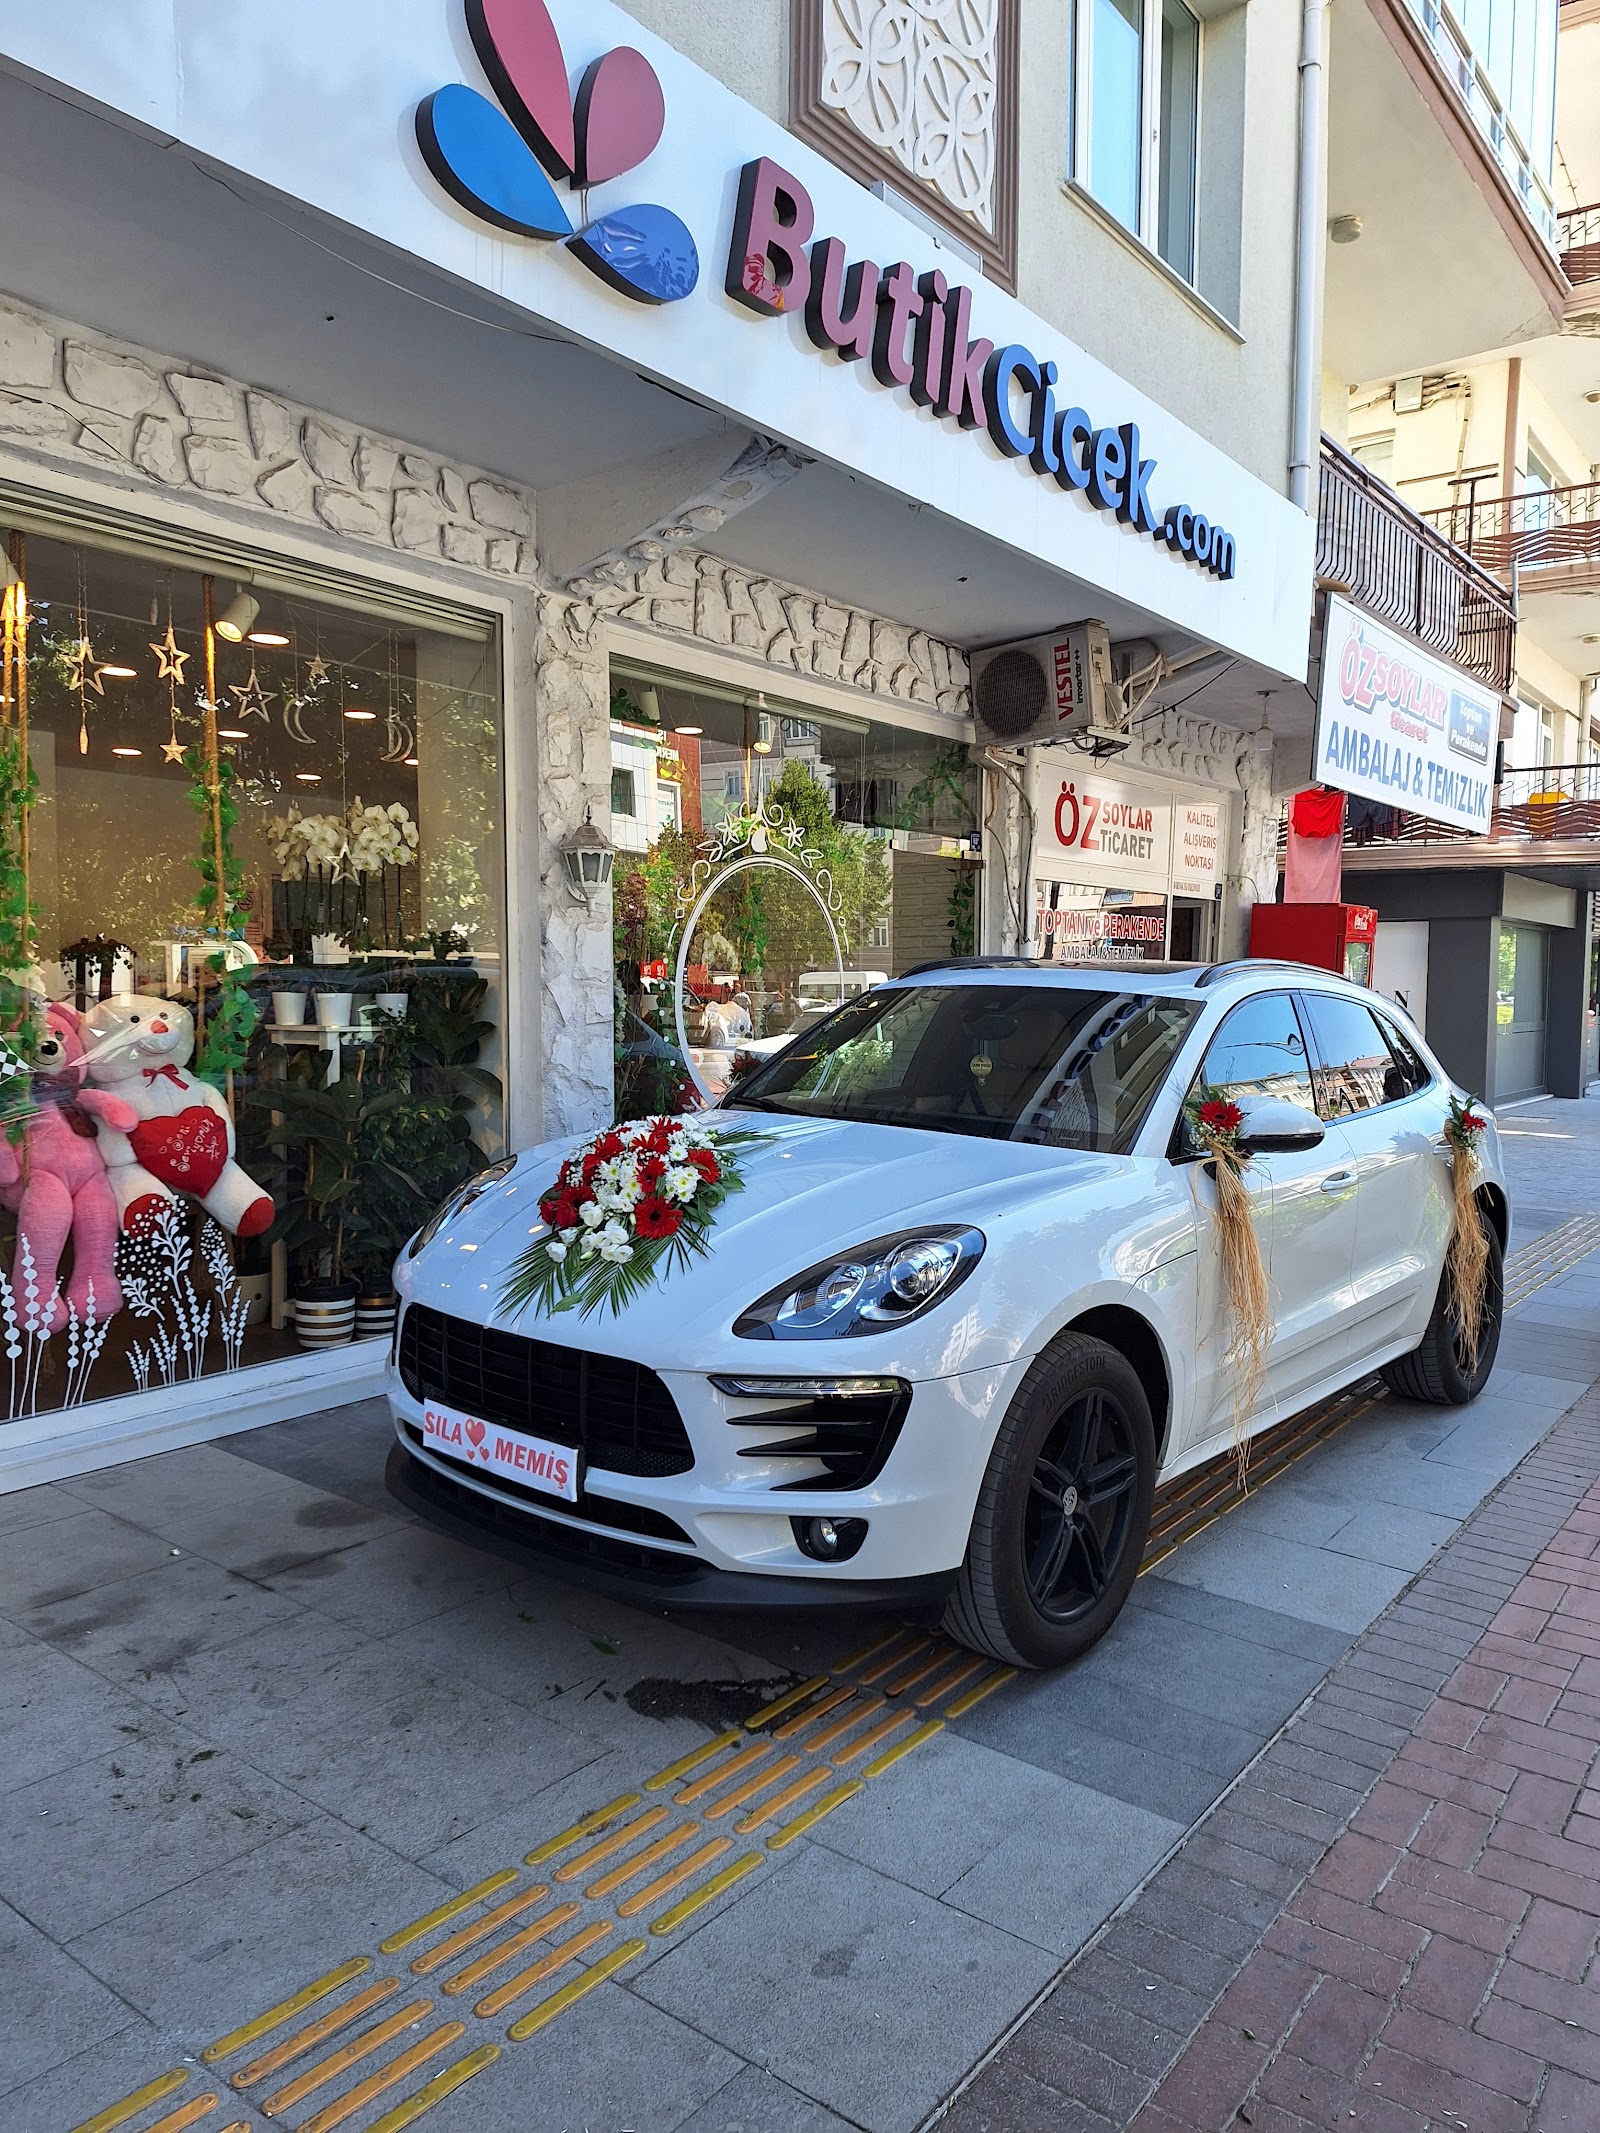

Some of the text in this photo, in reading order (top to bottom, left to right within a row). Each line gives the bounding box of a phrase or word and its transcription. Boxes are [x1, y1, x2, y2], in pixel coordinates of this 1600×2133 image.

[1054, 637, 1074, 721] VESTEL
[1391, 710, 1429, 743] ticaret
[1460, 701, 1483, 724] Toptan
[1451, 728, 1487, 757] Perakende
[1325, 721, 1411, 793] AMBALAJ
[1413, 756, 1423, 797] &
[1102, 801, 1153, 832] SOYLAR
[1186, 811, 1216, 828] KALİTELİ
[1183, 832, 1217, 853] ALIŞVERİŞ
[1184, 854, 1214, 870] NOKTASI
[1037, 908, 1165, 940] TOPTAN ve PERAKENDE
[1061, 944, 1099, 960] AMBALAJ
[424, 1411, 570, 1490] SILA MEMİŞ
